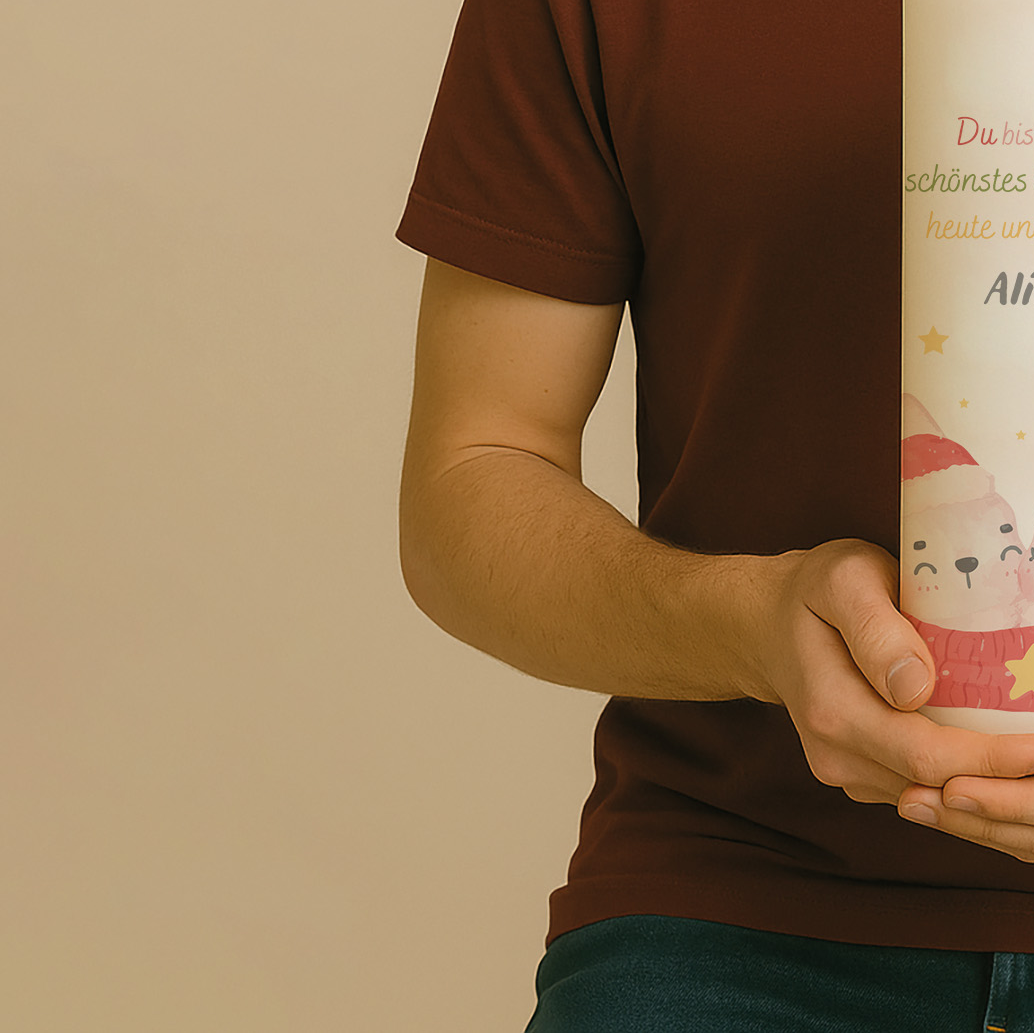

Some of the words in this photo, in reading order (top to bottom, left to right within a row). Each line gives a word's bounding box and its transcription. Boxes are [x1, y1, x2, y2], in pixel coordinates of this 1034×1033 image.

[957, 116, 998, 146] Du
[904, 163, 1027, 193] schönstes
[926, 210, 996, 240] heute
